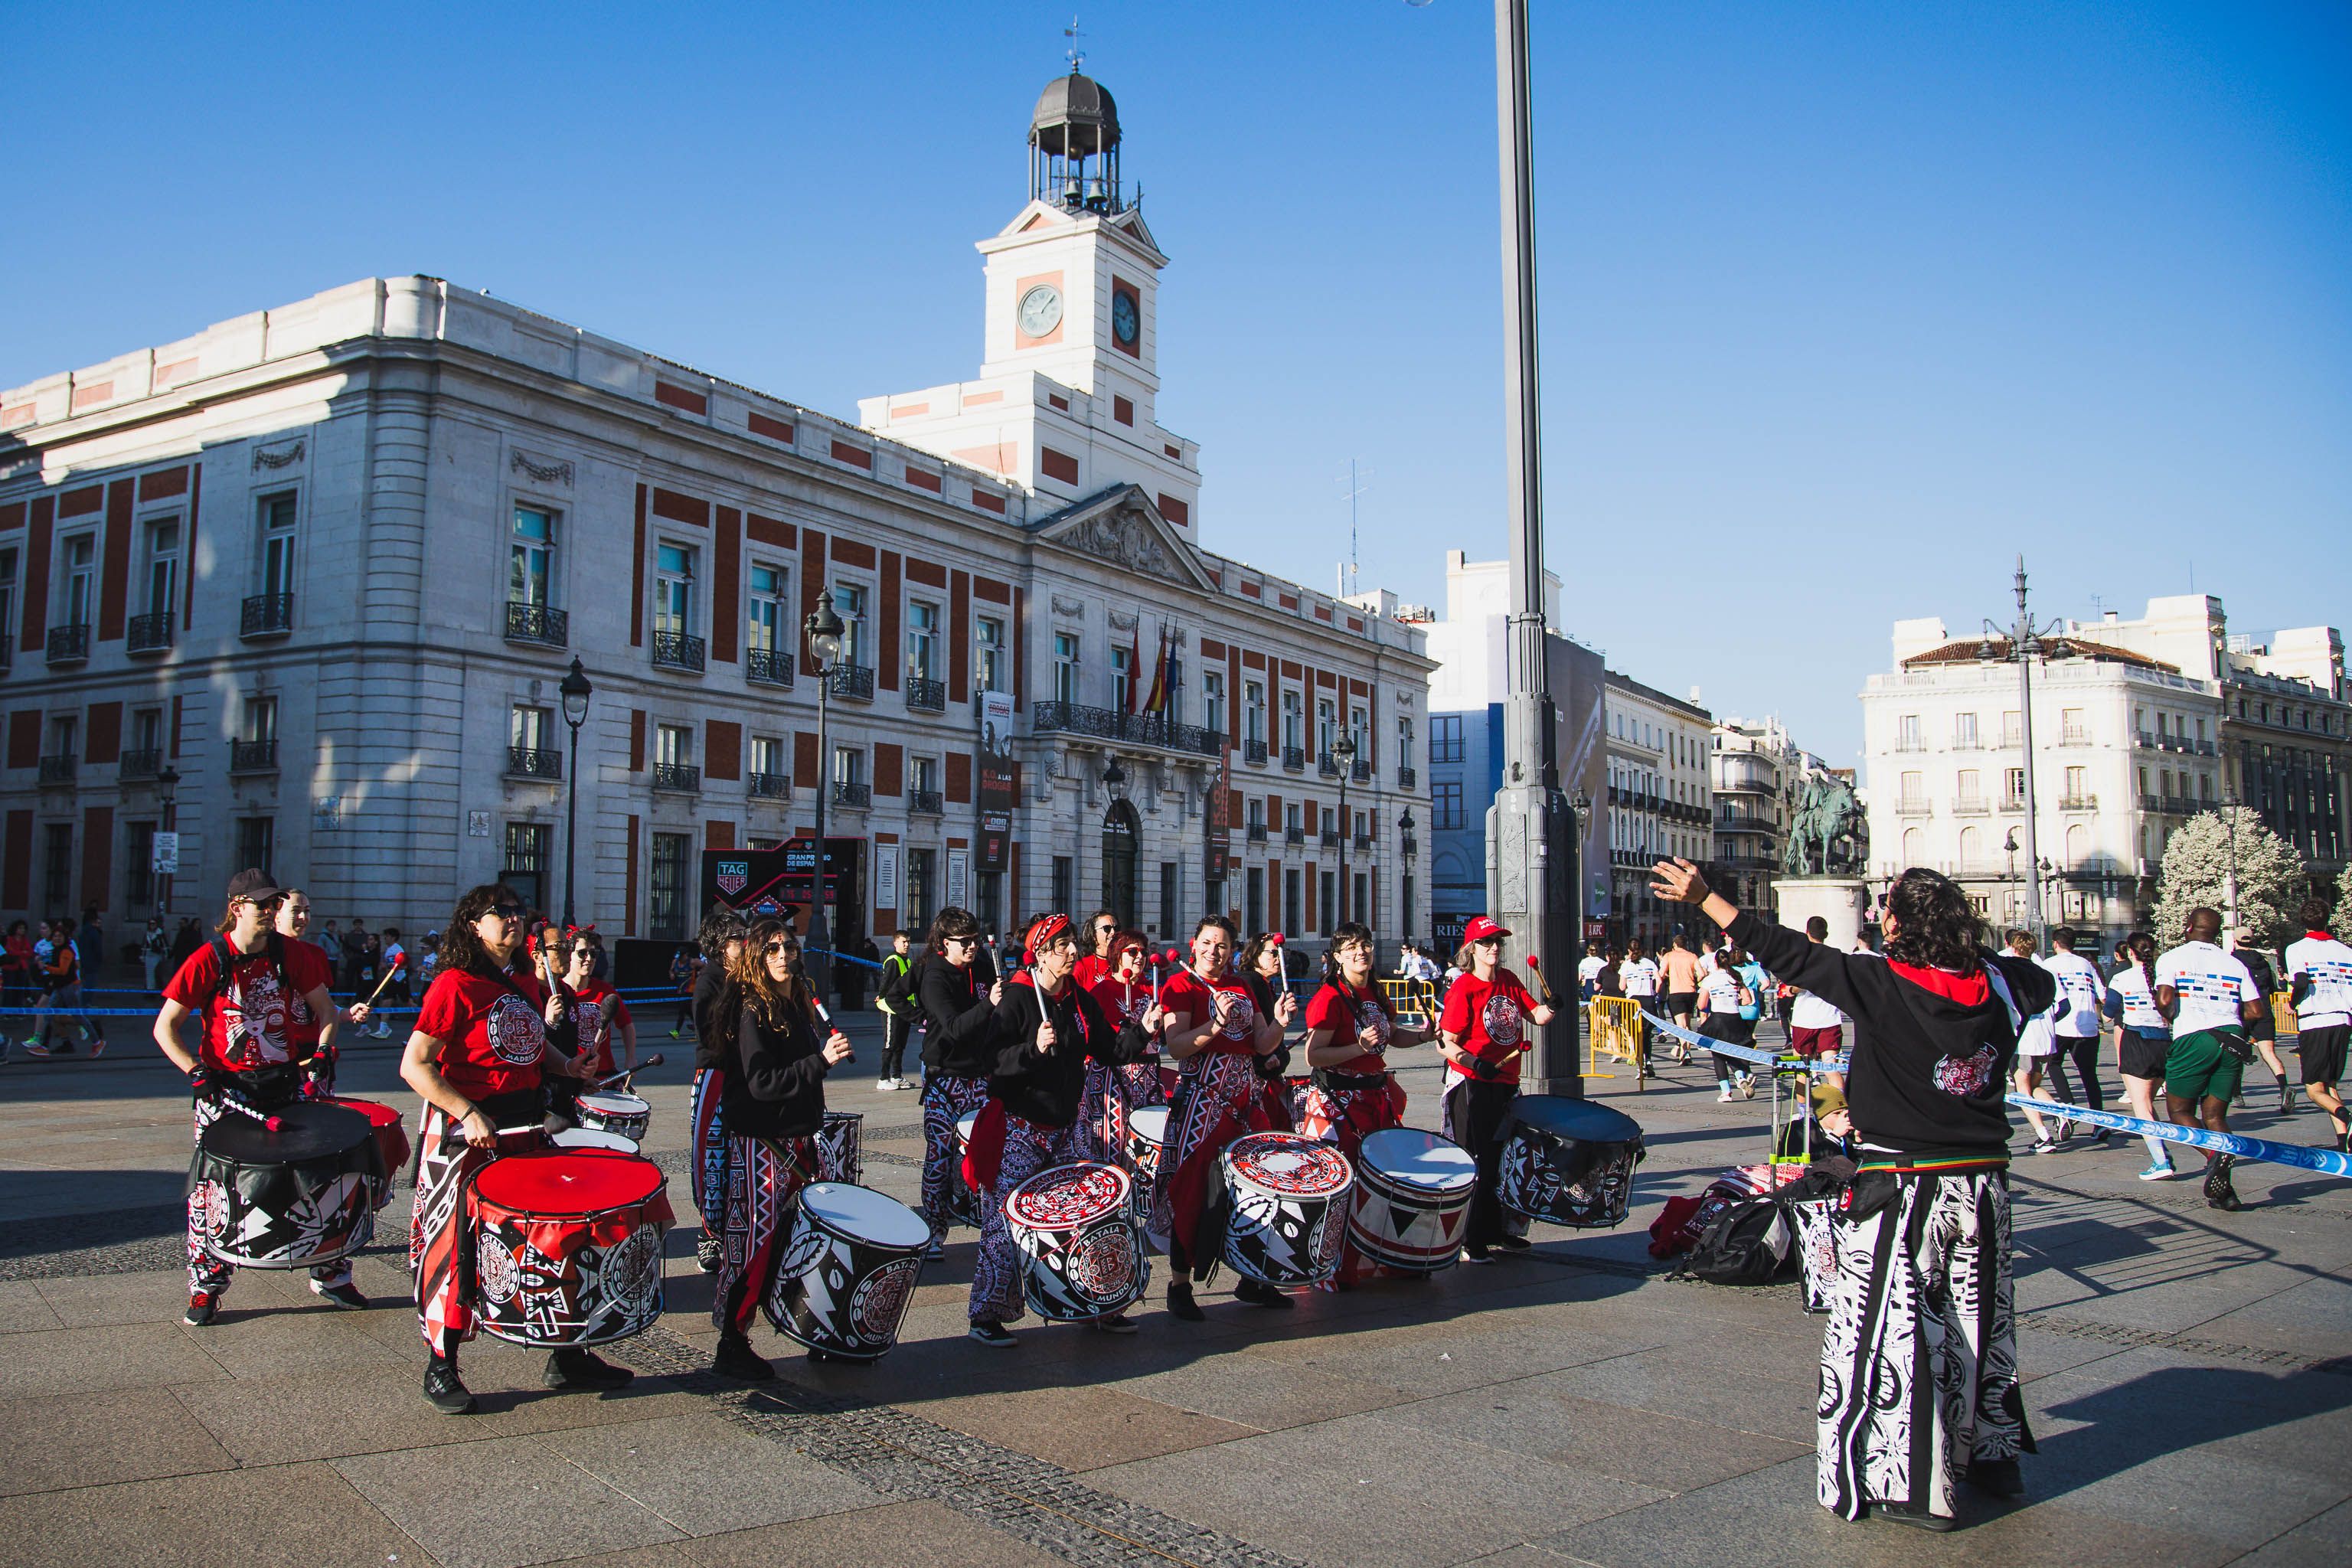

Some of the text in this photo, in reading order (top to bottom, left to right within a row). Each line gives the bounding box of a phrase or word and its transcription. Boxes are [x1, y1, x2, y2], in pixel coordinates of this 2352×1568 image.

[982, 780, 1011, 792] DROGAS
[720, 864, 745, 874] TAG
[719, 877, 745, 892] HEUER
[1592, 925, 1602, 936] KFC
[505, 1053, 536, 1063] MADRID
[1237, 1136, 1279, 1163] BATALA
[1570, 1195, 1594, 1204] MUNDO
[1083, 1225, 1120, 1246] BATALA
[481, 1234, 508, 1256] BATALA
[1097, 1282, 1130, 1302] MUNDO
